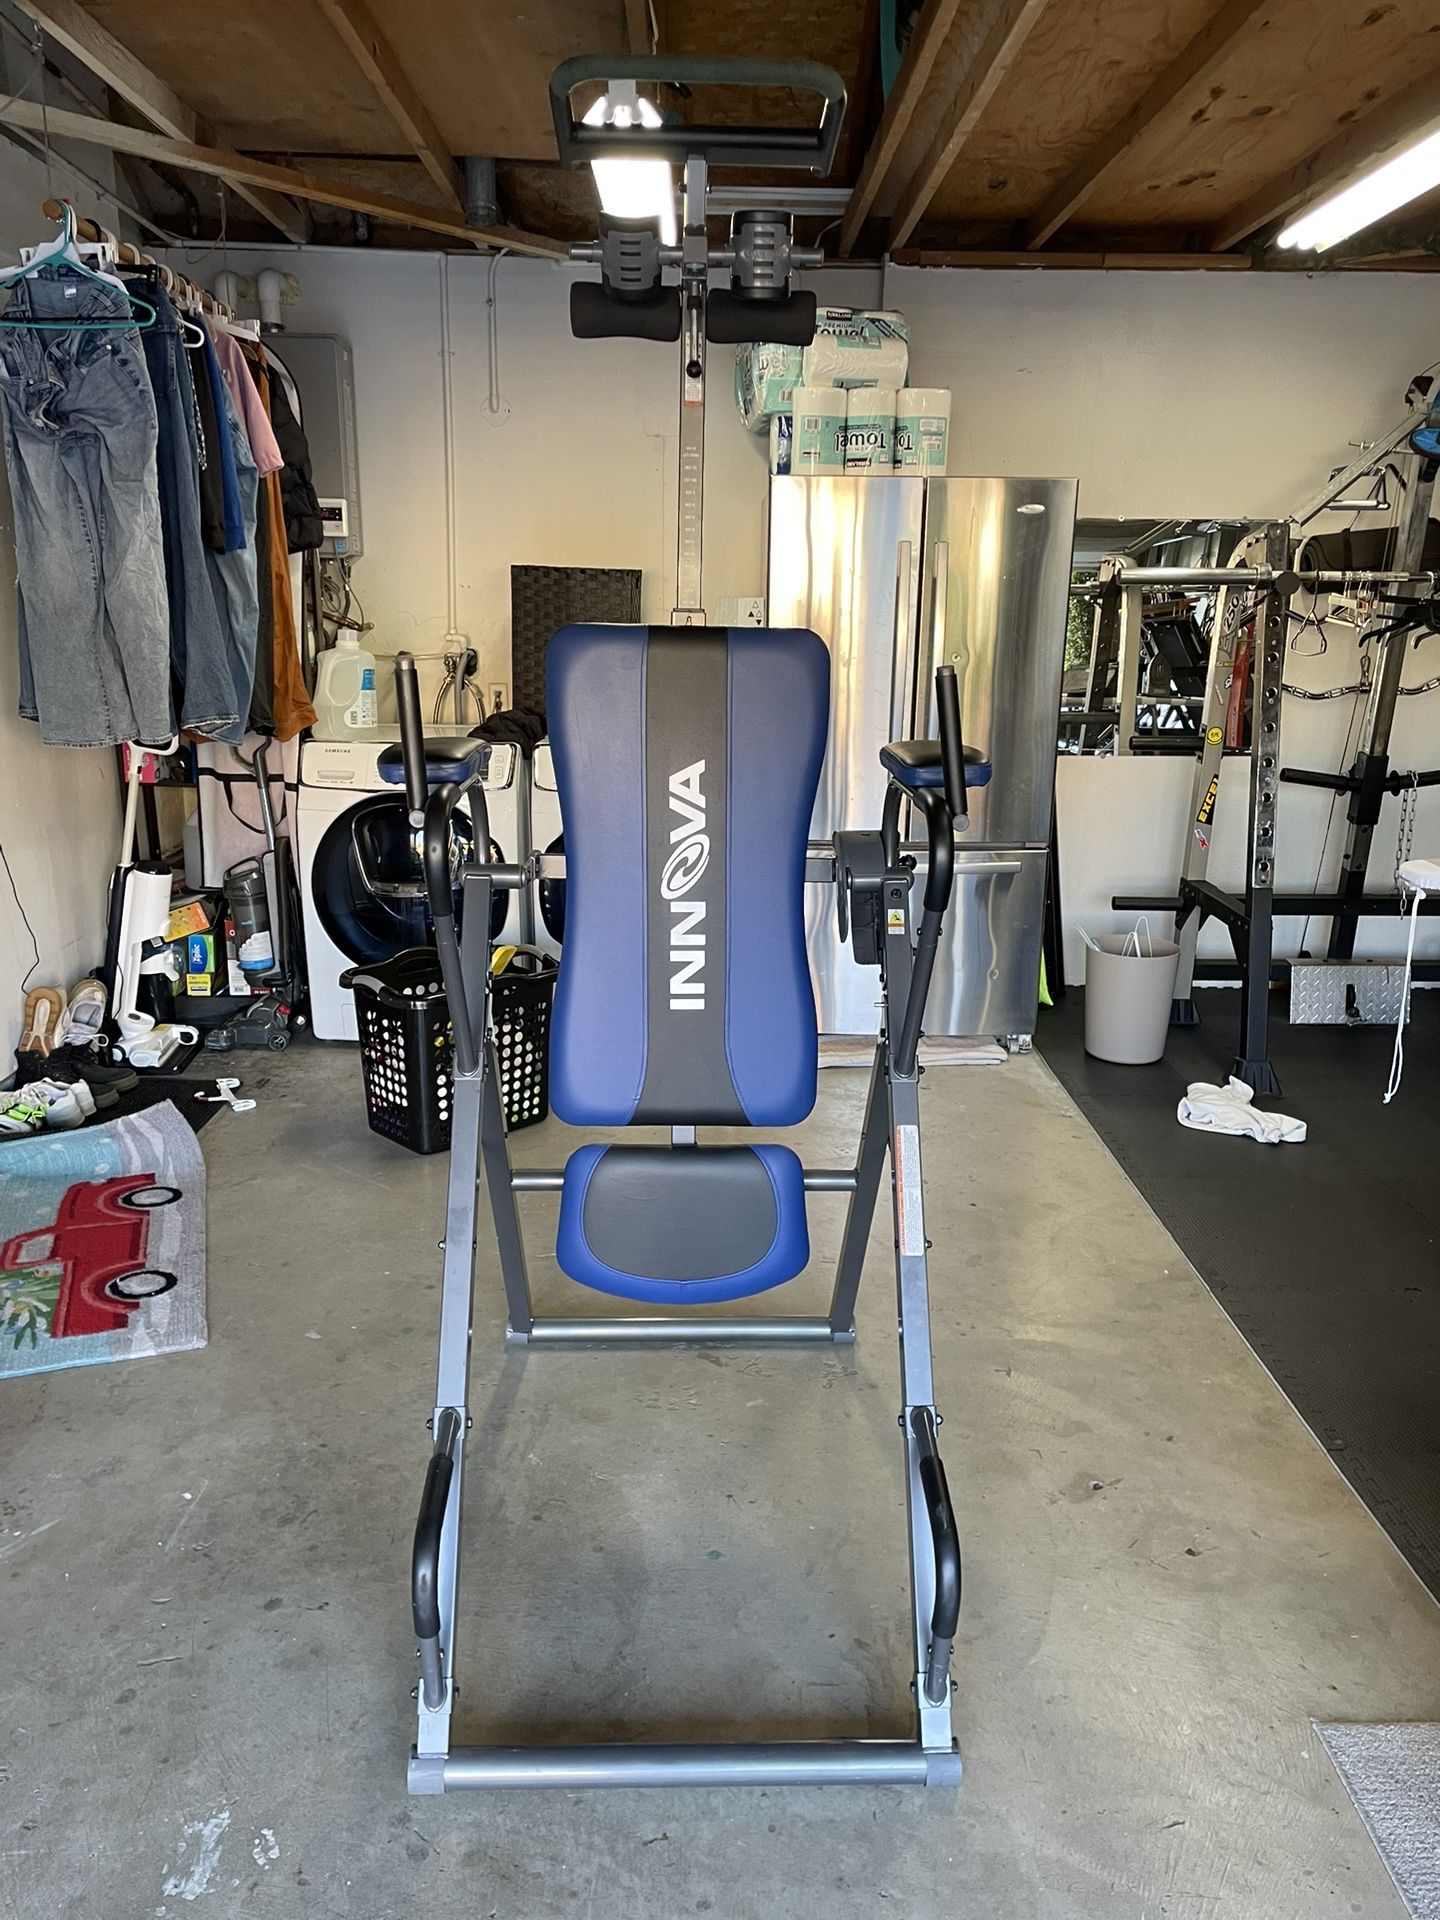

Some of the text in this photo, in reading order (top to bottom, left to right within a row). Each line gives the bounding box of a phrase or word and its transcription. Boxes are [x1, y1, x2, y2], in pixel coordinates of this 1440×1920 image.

[836, 433, 886, 451] Towel
[1223, 595, 1240, 631] 250
[660, 759, 710, 1010] INNOVA
[191, 943, 203, 965] Ziploc
